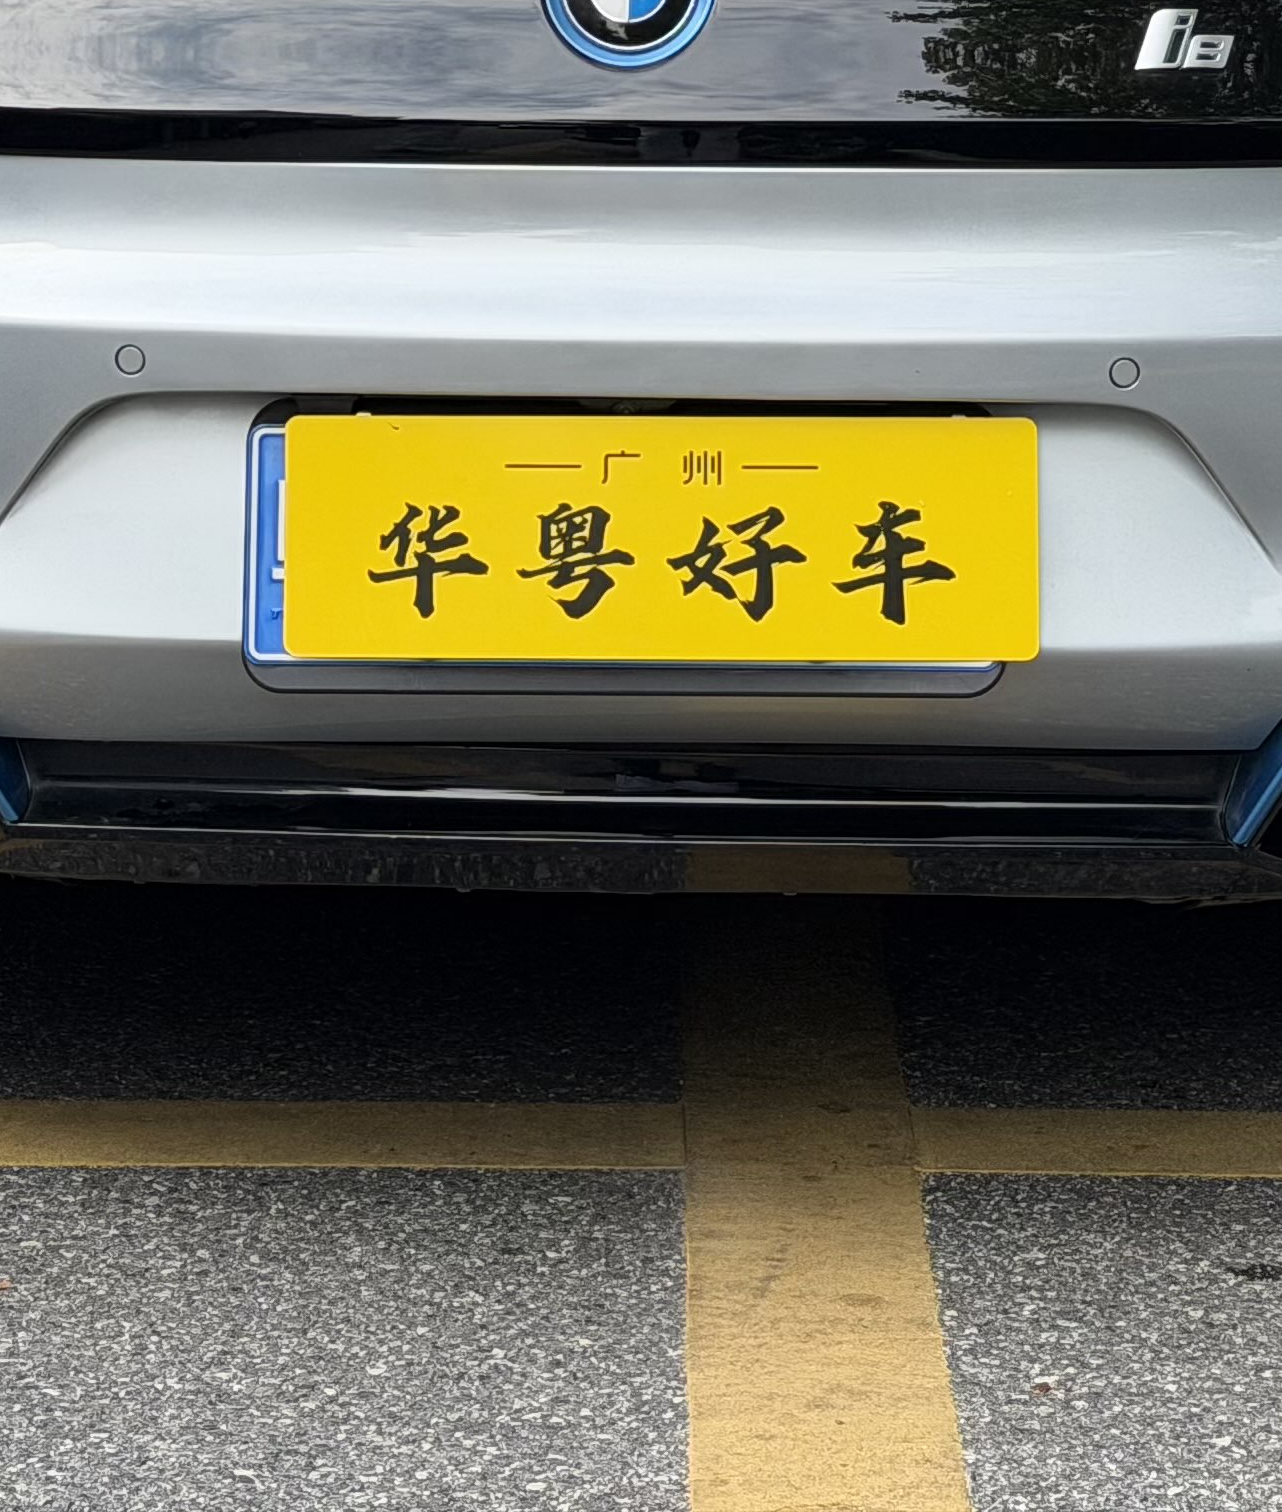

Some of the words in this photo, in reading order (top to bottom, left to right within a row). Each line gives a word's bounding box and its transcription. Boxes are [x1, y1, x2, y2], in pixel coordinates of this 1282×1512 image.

[1134, 8, 1235, 70] i8
[601, 449, 722, 485] 广州
[367, 501, 957, 626] 华粤好车
